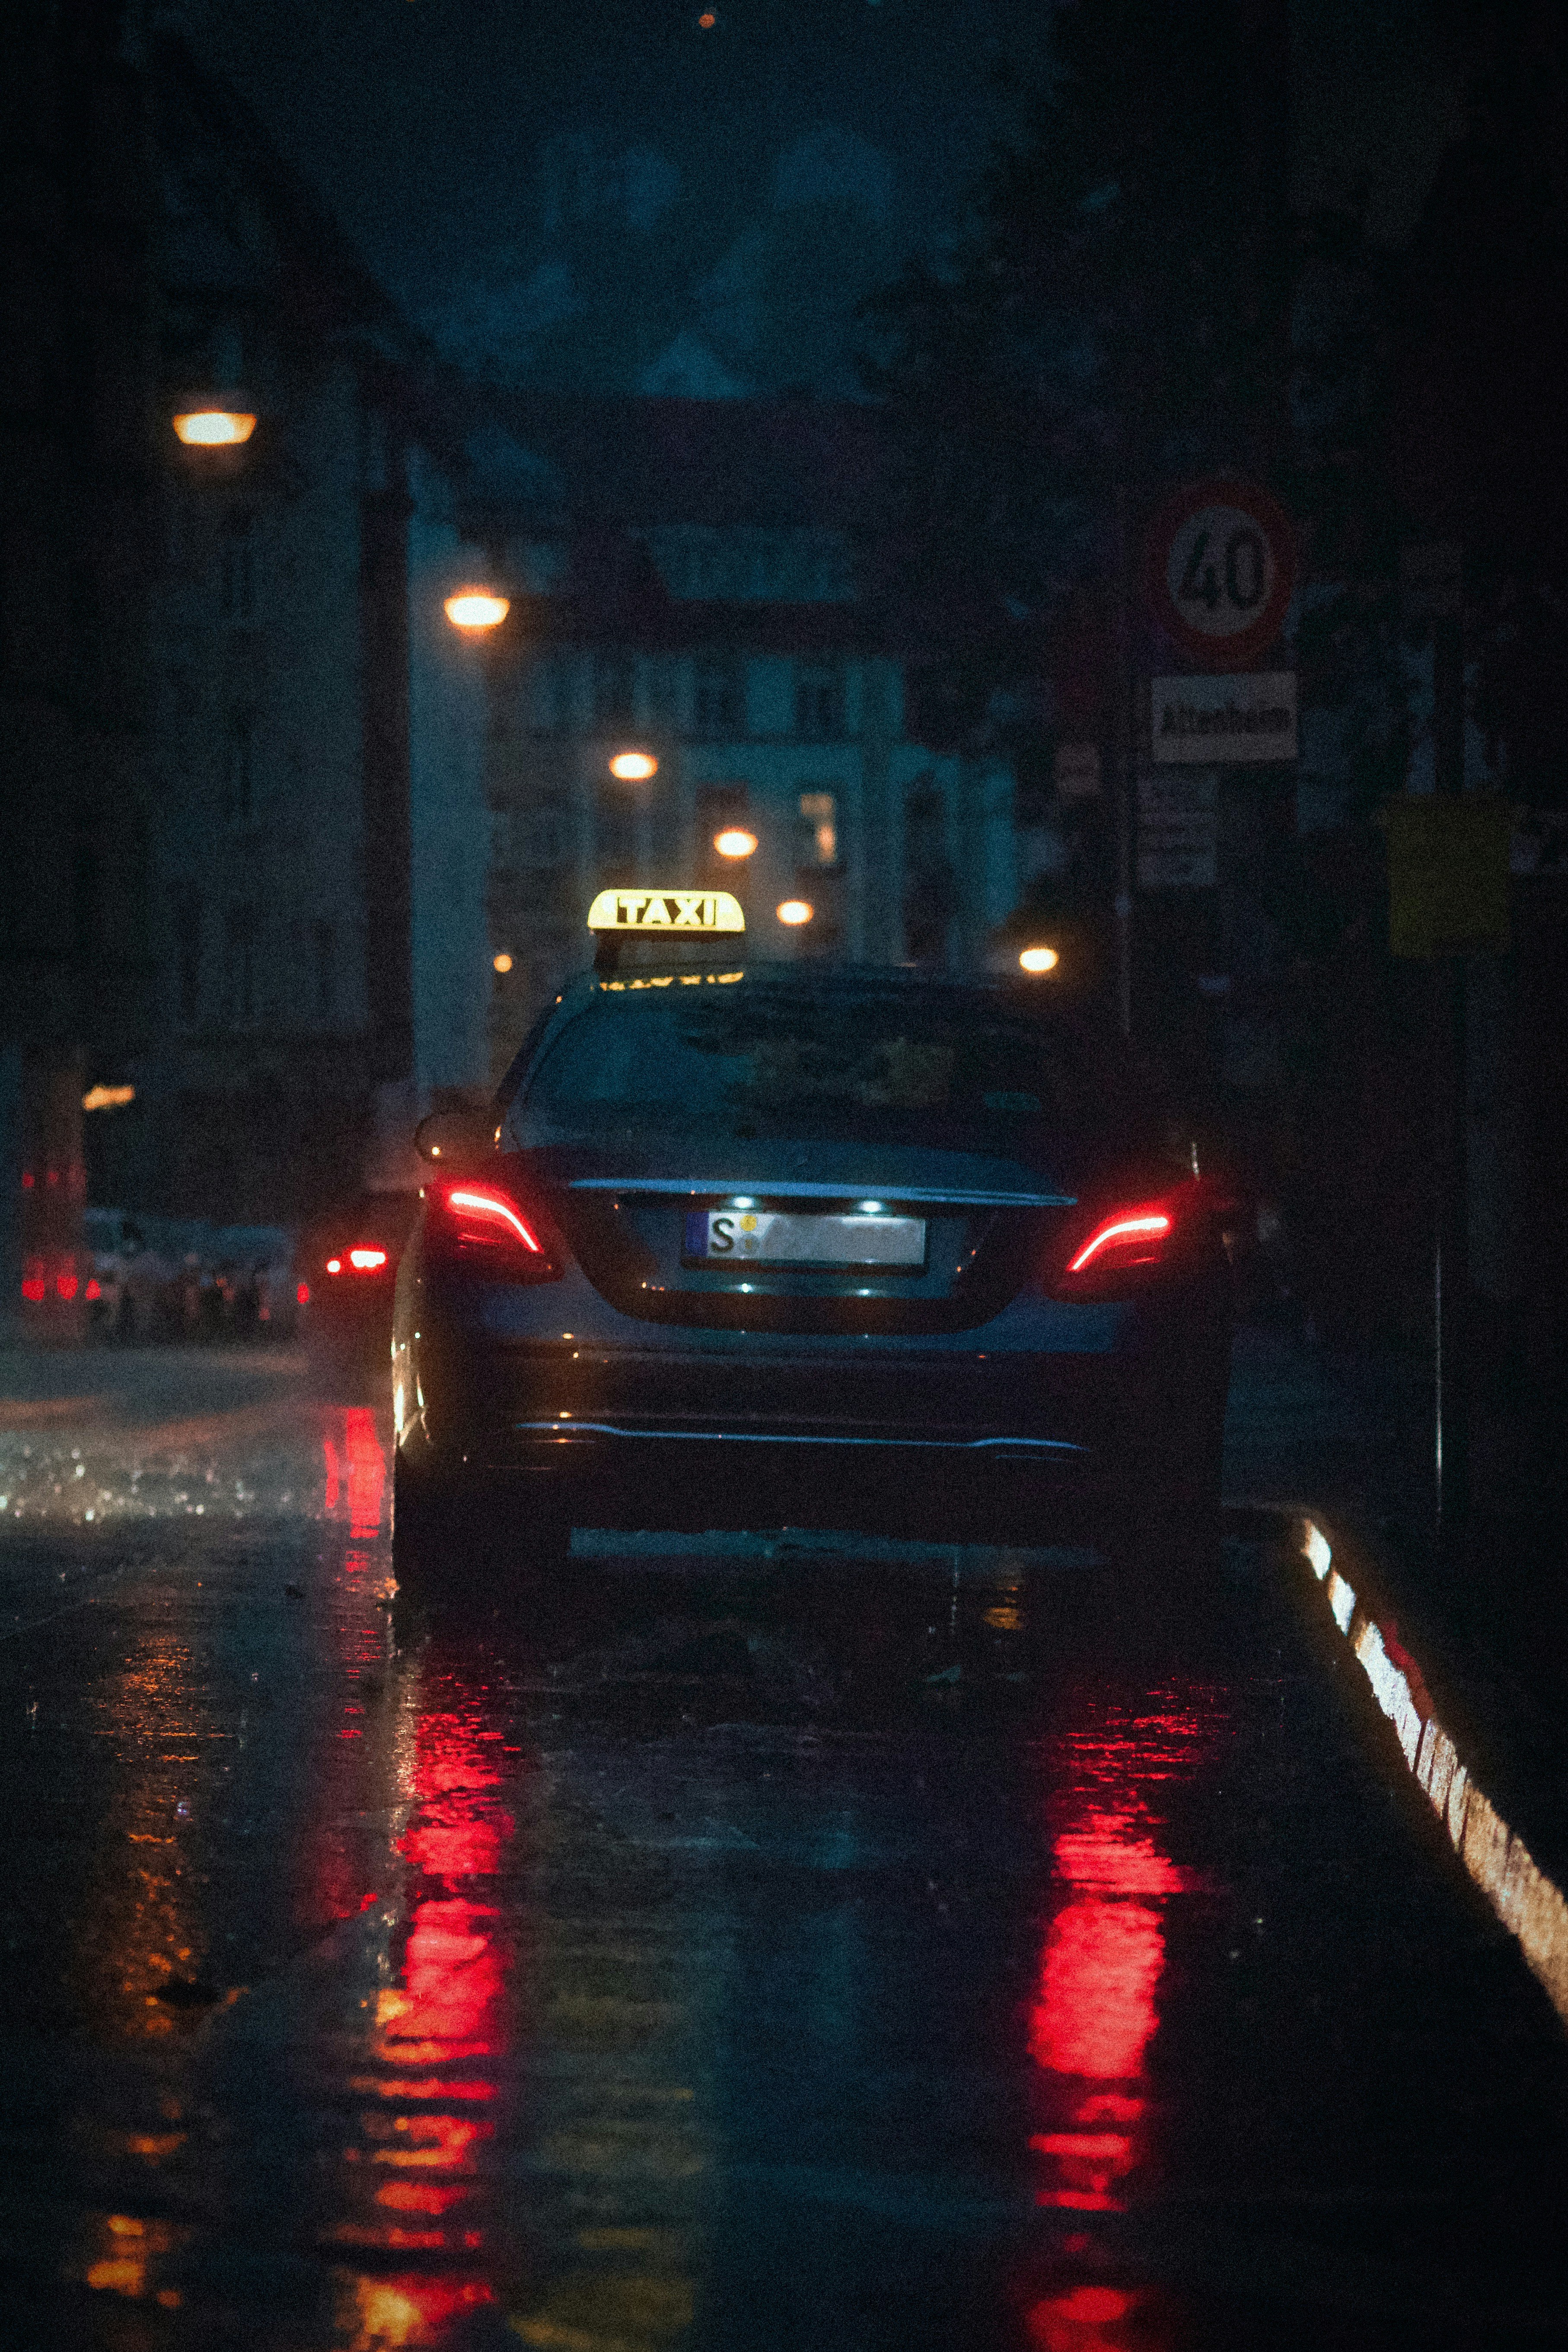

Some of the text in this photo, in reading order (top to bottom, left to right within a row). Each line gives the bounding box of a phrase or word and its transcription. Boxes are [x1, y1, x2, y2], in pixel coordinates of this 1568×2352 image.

[1179, 530, 1264, 610] 40
[618, 897, 715, 925] TAXI
[711, 1218, 734, 1252] S
